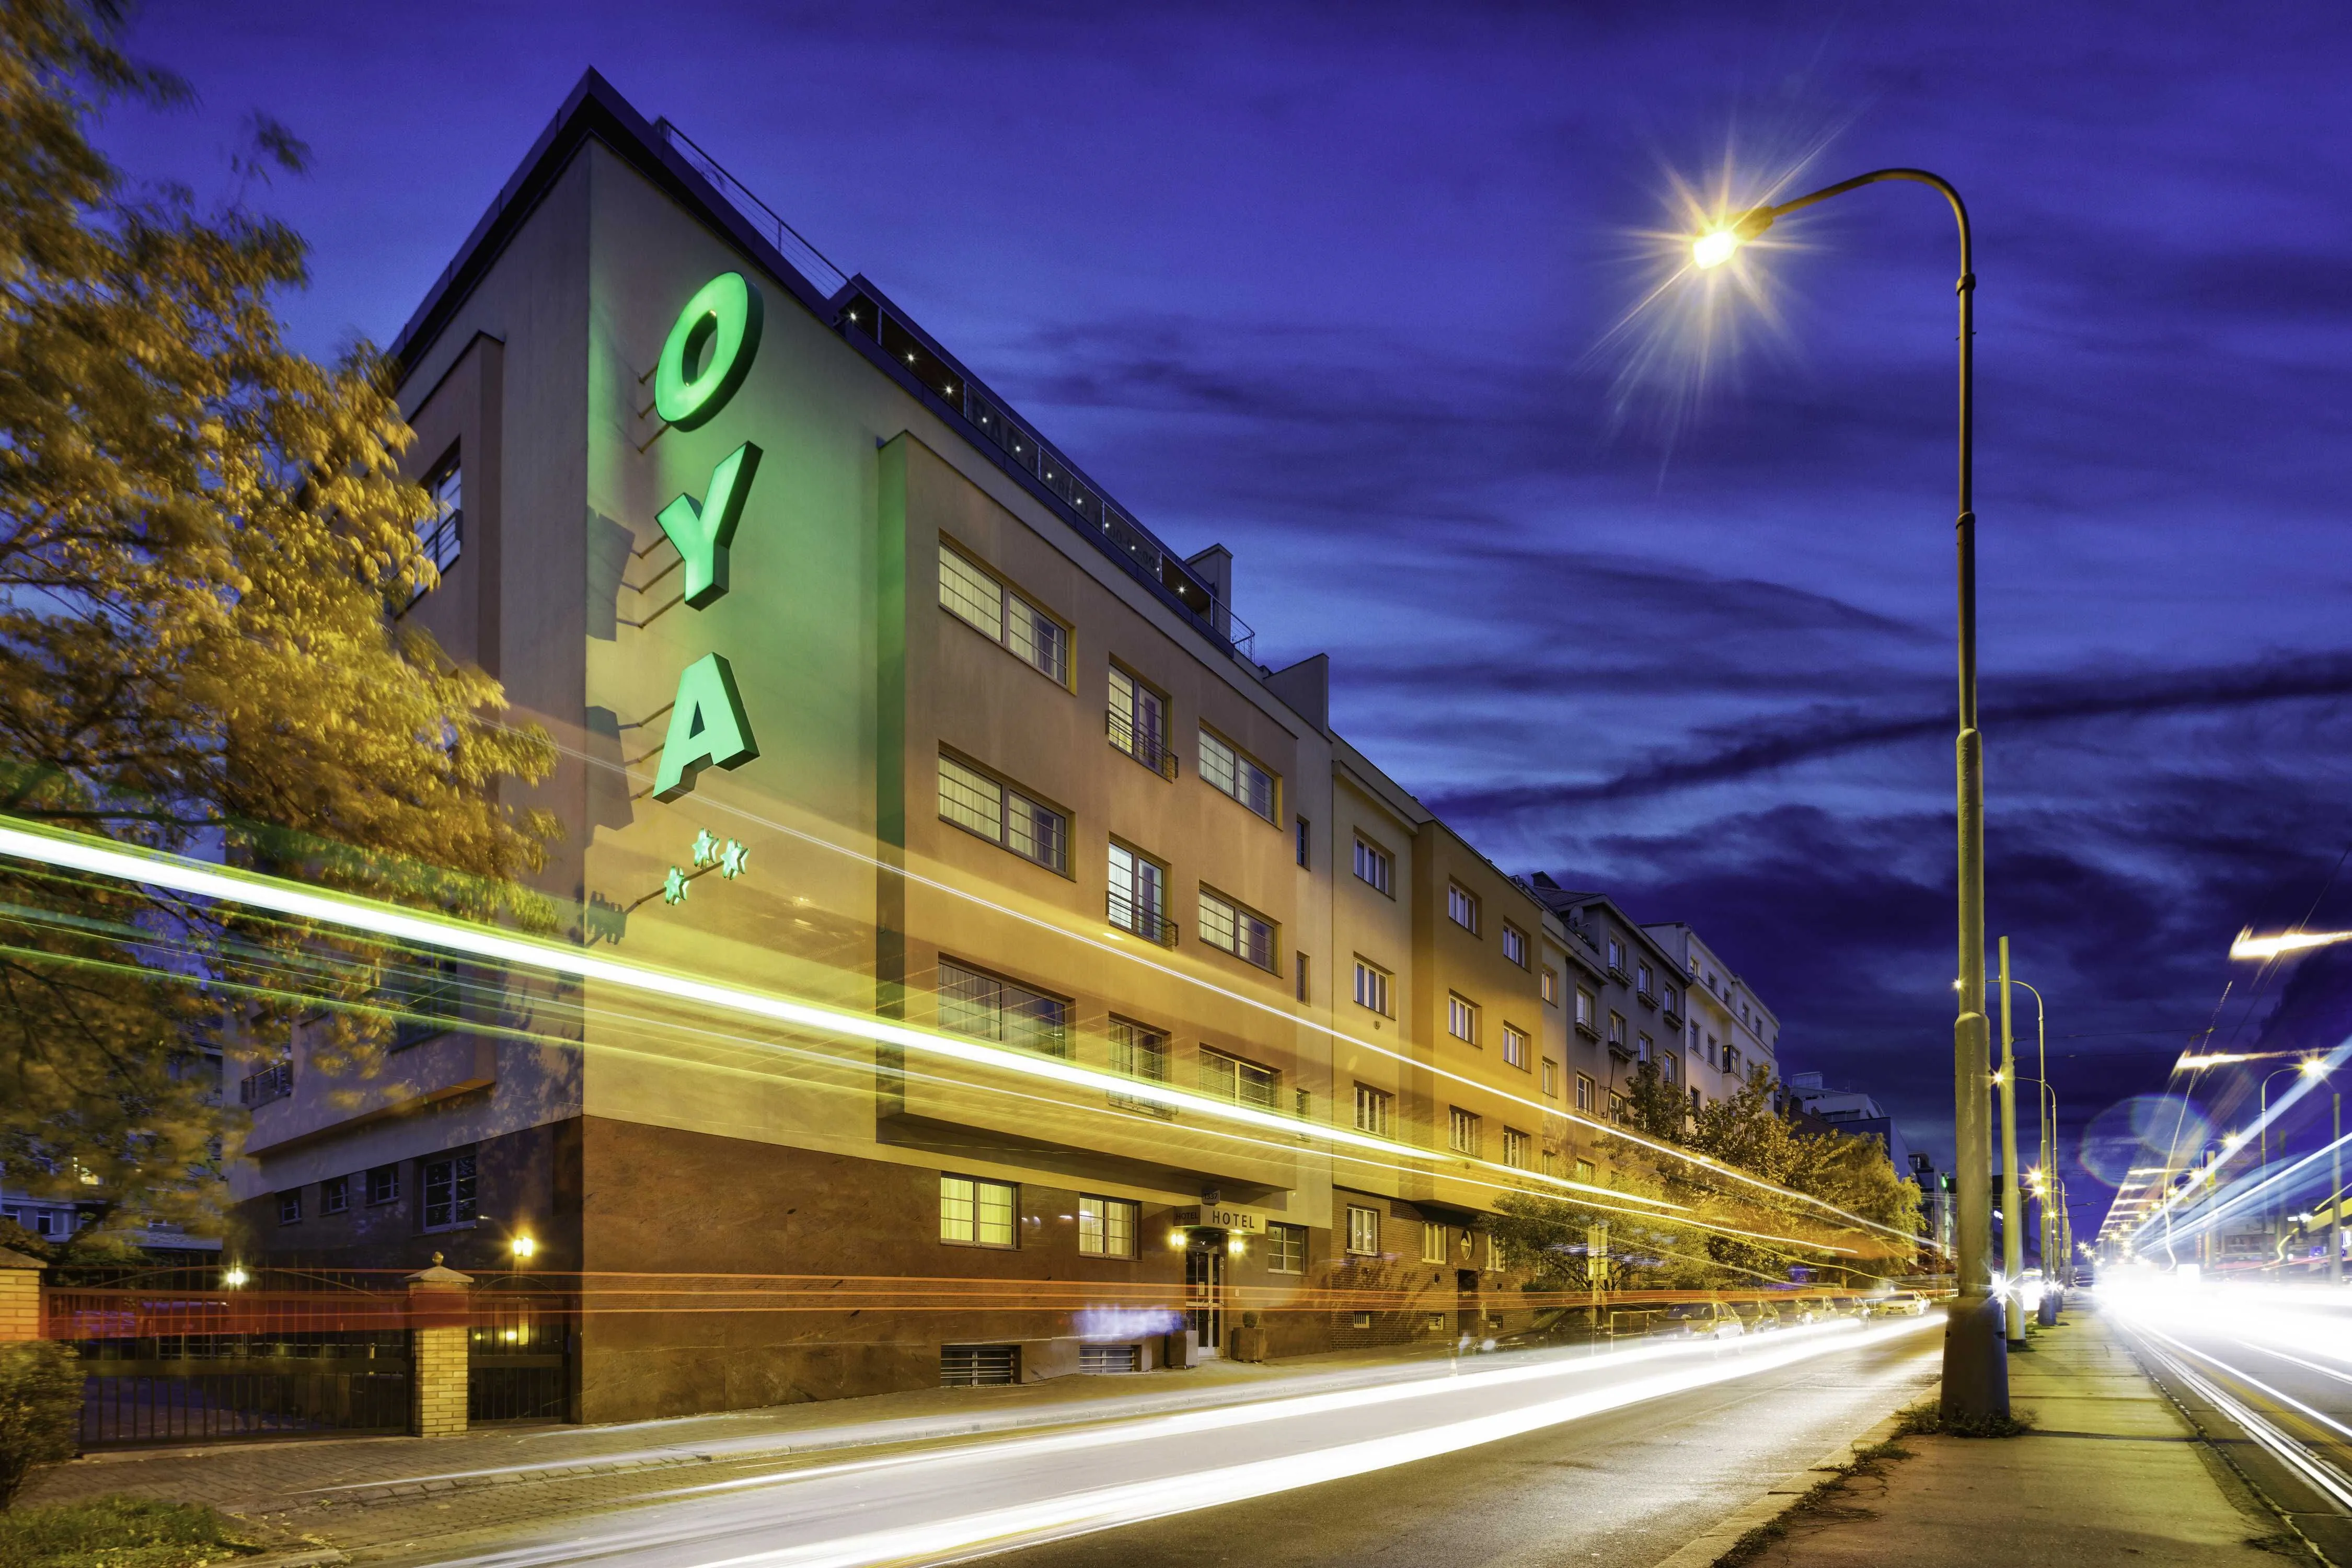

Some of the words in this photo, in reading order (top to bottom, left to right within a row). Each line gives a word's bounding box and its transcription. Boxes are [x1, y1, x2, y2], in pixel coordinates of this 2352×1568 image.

[653, 271, 764, 803] OYA
[1176, 1212, 1197, 1220] HOTEL
[1213, 1210, 1255, 1229] HOTEL
